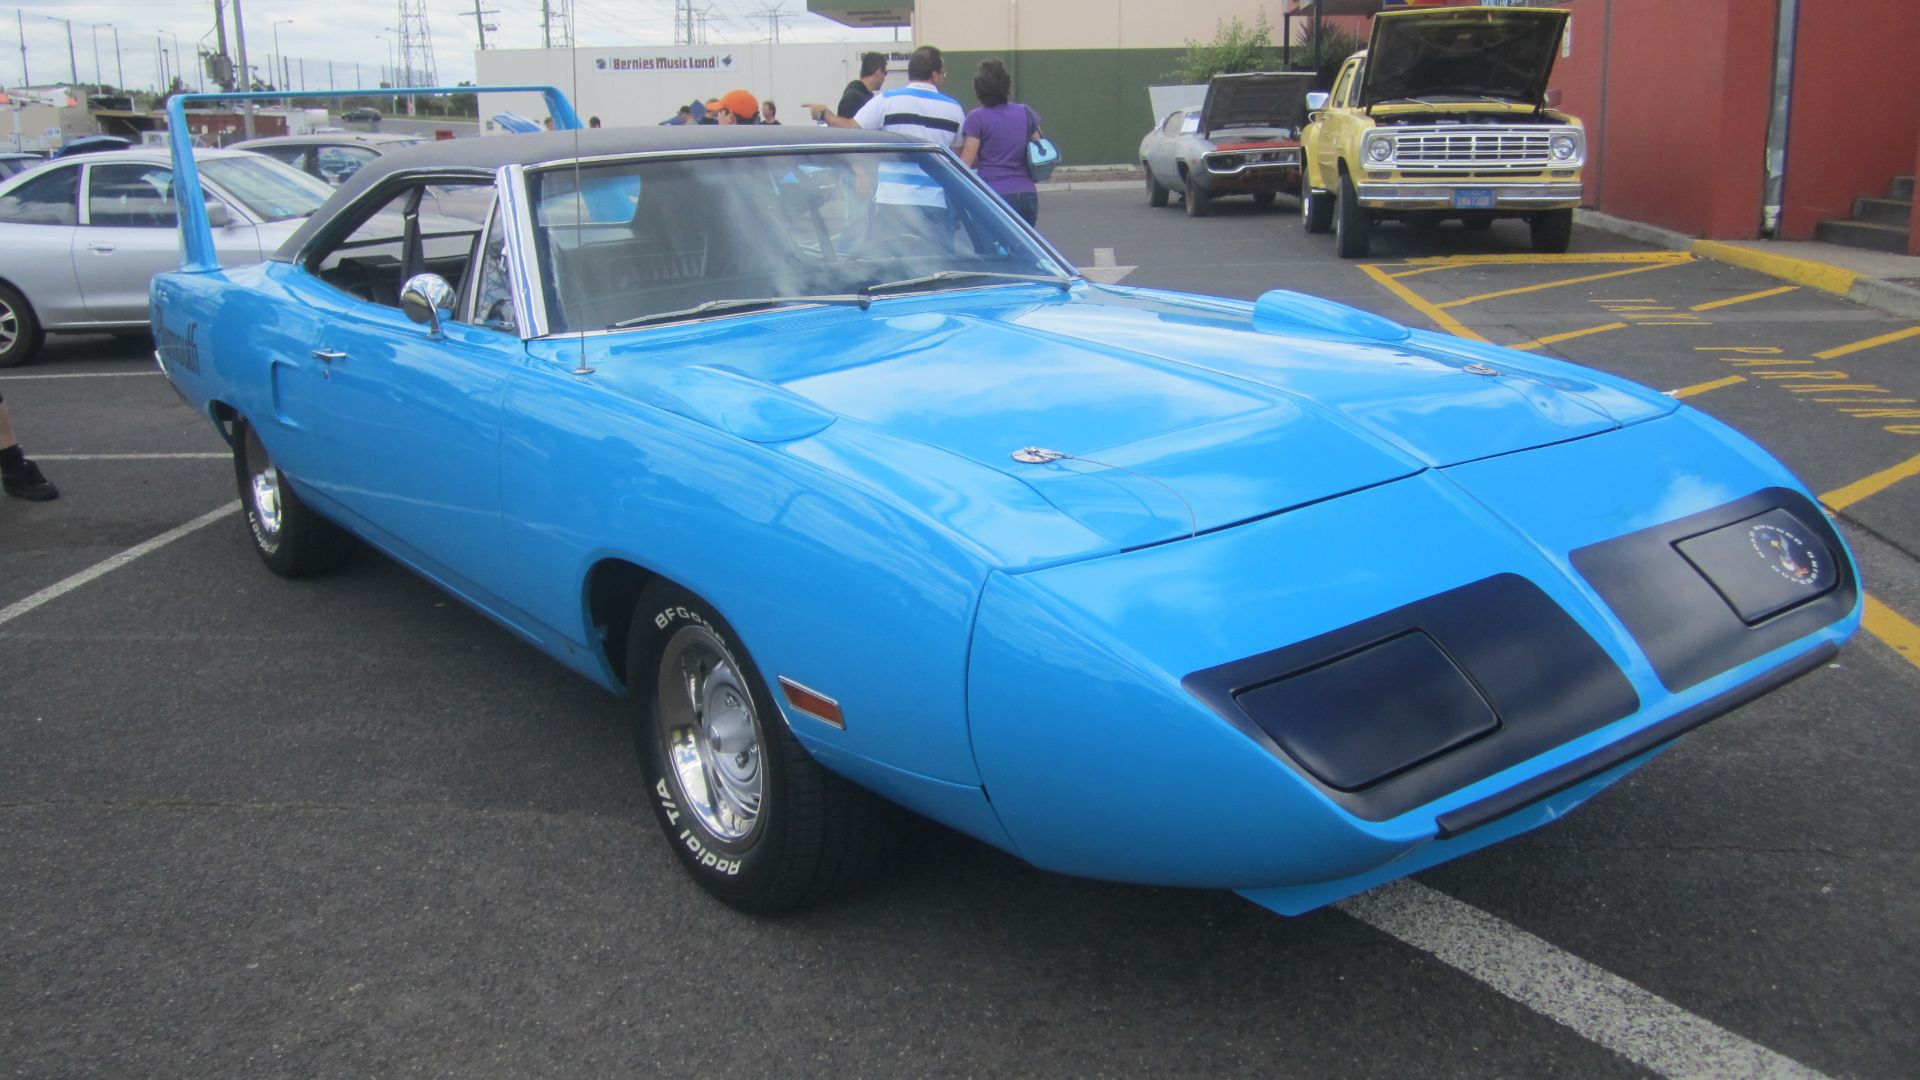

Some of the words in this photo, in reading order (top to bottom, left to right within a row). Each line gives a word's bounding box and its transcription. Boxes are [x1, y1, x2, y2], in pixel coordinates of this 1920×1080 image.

[613, 57, 654, 70] Bernies
[656, 57, 688, 69] Music
[689, 56, 715, 68] Land
[656, 777, 680, 826] T/A
[679, 829, 742, 875] Radial
